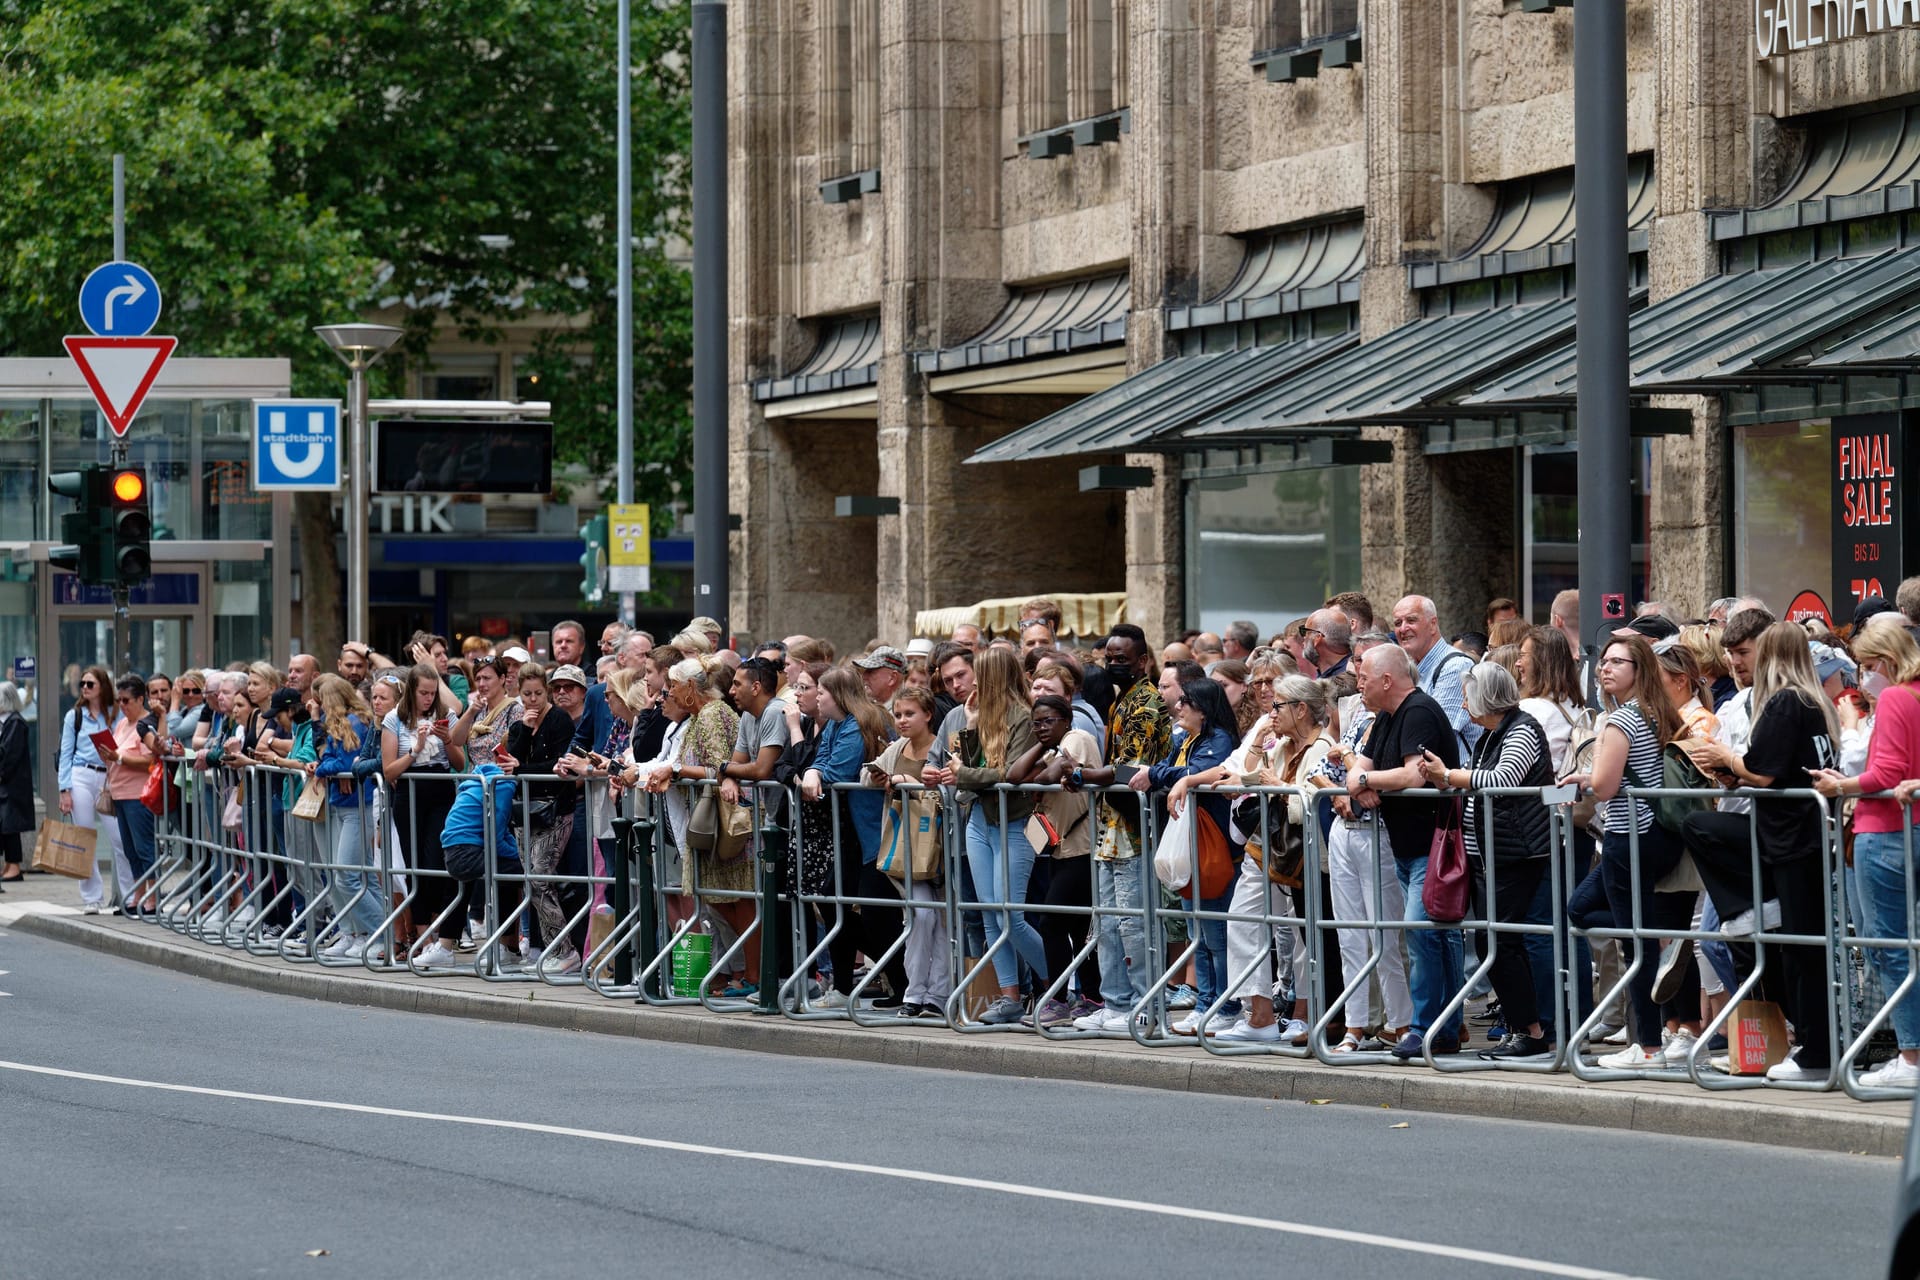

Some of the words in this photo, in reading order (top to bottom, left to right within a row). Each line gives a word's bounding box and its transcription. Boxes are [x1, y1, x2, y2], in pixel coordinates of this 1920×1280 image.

[263, 433, 332, 443] stadtbahn
[270, 412, 324, 478] U
[1839, 434, 1894, 480] FINAL
[1843, 481, 1892, 526] SALE
[1854, 544, 1867, 561] BIS
[1869, 544, 1880, 561] ZU
[1743, 1018, 1761, 1032] THE
[1744, 1034, 1768, 1049] ONLY
[1745, 1050, 1766, 1065] BAG
